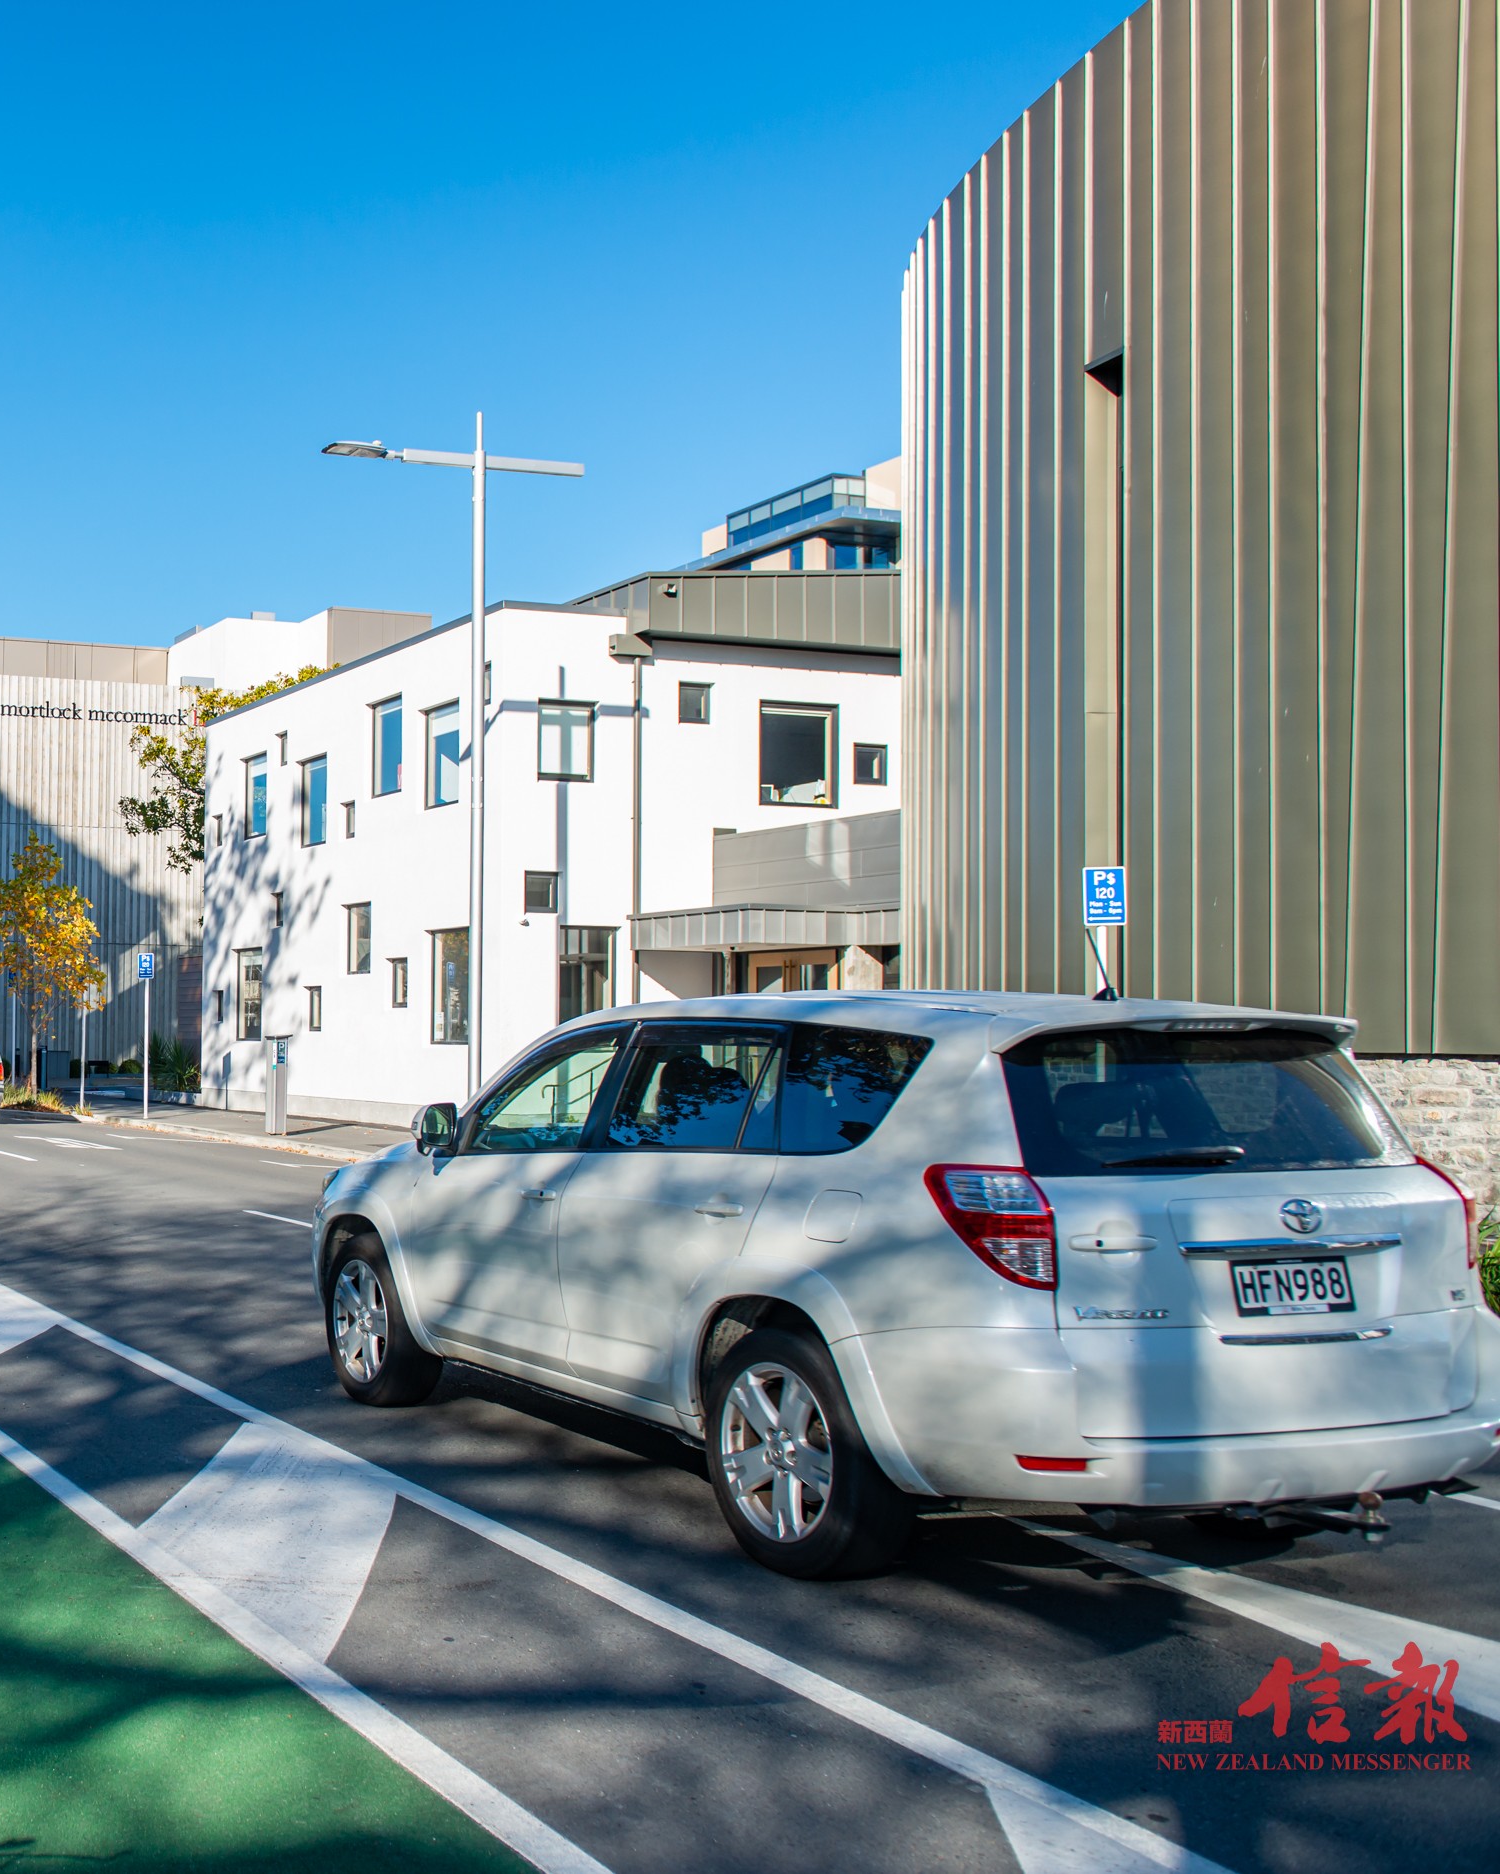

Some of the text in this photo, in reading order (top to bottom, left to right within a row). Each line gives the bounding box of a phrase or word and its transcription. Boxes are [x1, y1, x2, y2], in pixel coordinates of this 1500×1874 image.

[0, 701, 82, 720] mortlock
[88, 708, 188, 726] mccormack
[1093, 870, 1116, 886] P$
[1095, 887, 1115, 899] 120
[1238, 1267, 1345, 1304] HFN988
